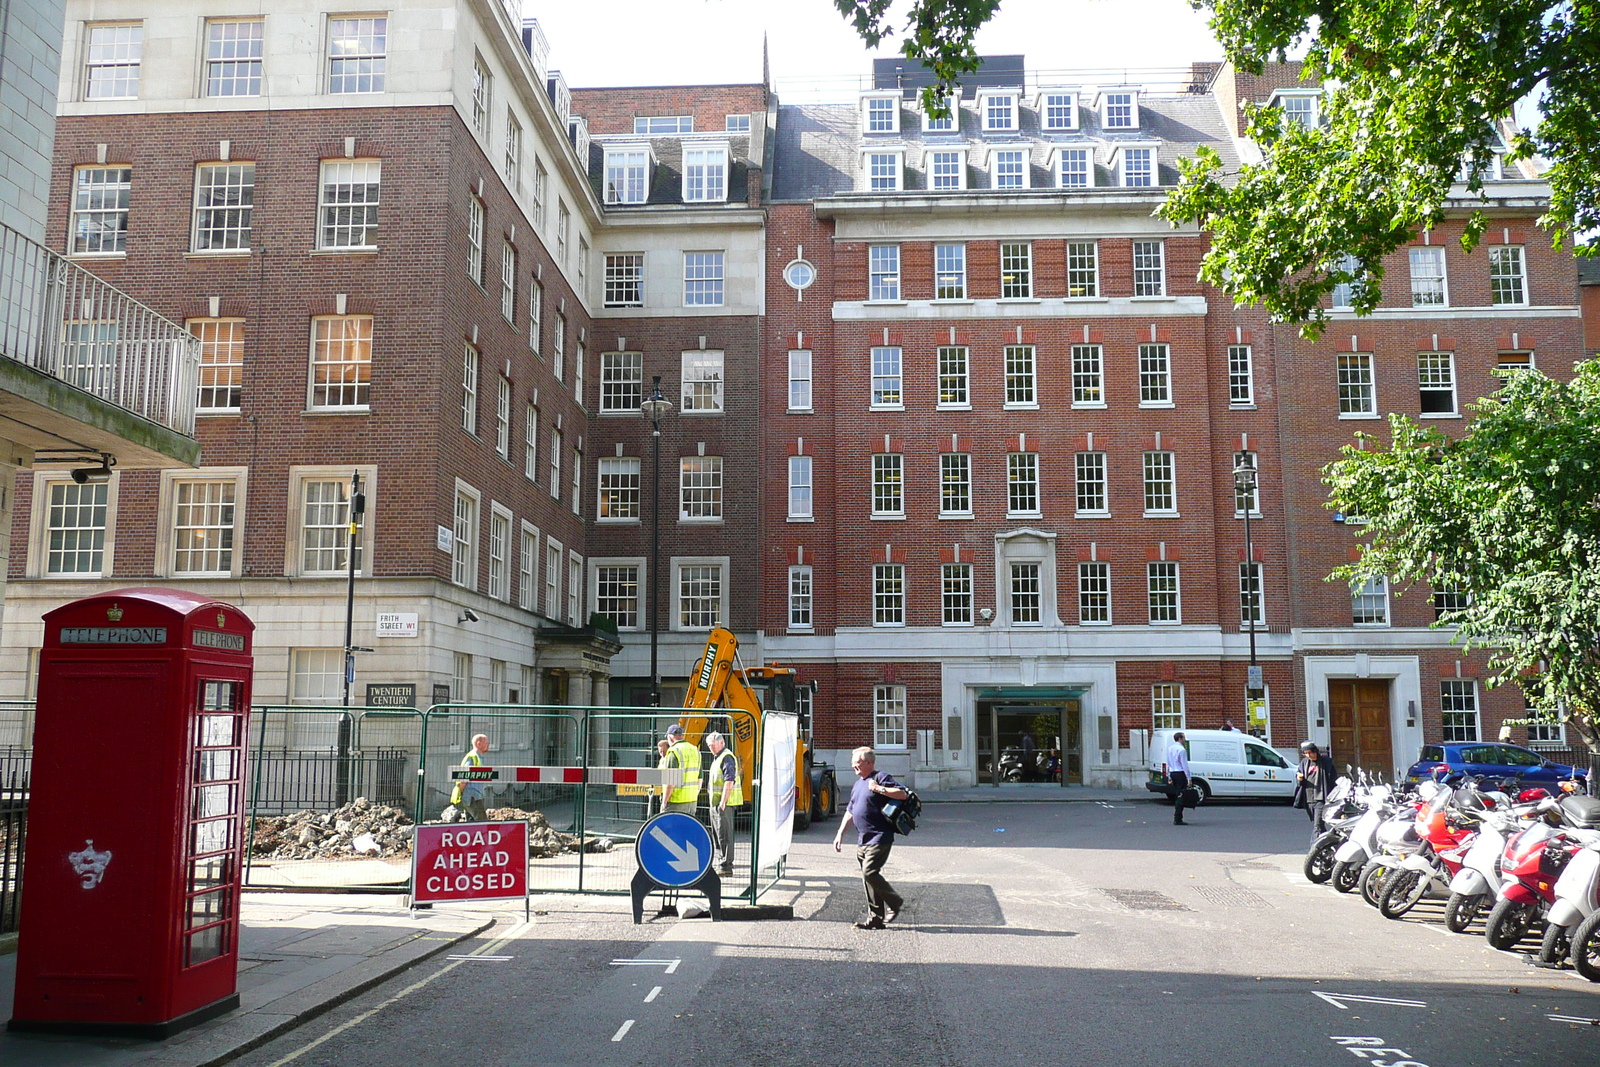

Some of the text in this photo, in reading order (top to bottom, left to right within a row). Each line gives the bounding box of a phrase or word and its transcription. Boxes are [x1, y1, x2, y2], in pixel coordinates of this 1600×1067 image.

[65, 628, 163, 642] TELEPHONE
[194, 630, 243, 650] TELEPHONE
[699, 645, 716, 688] MURPHY
[370, 687, 412, 696] TWENTIETH
[372, 696, 409, 705] CENTURY
[735, 717, 751, 740] JCB
[457, 771, 493, 779] MURPHY
[441, 830, 502, 848] ROAD
[433, 851, 509, 870] AHEAD
[426, 873, 515, 893] CLOSED
